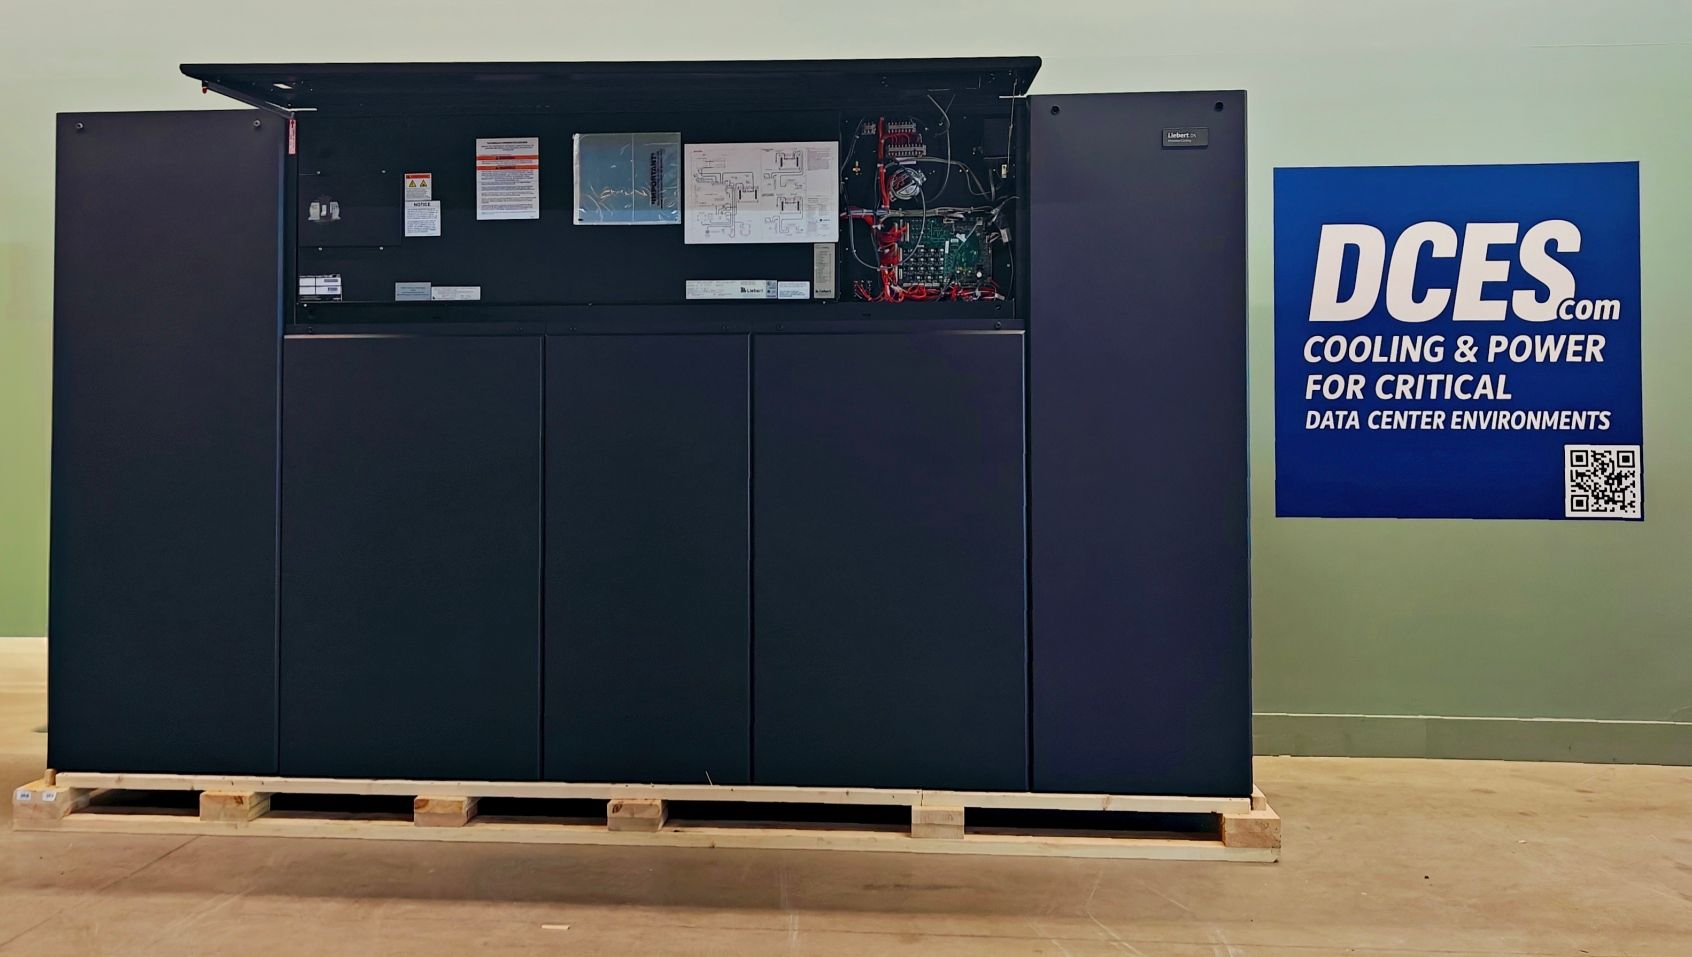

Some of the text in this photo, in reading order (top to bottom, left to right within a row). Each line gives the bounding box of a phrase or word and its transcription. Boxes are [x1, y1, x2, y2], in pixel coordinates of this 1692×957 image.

[1309, 220, 1581, 323] DCES
[1304, 335, 1605, 362] COOLING & POWER
[1306, 374, 1511, 399] FOR CRITICAL
[1306, 411, 1611, 429] DATA CENTER ENVIRONMENTS
